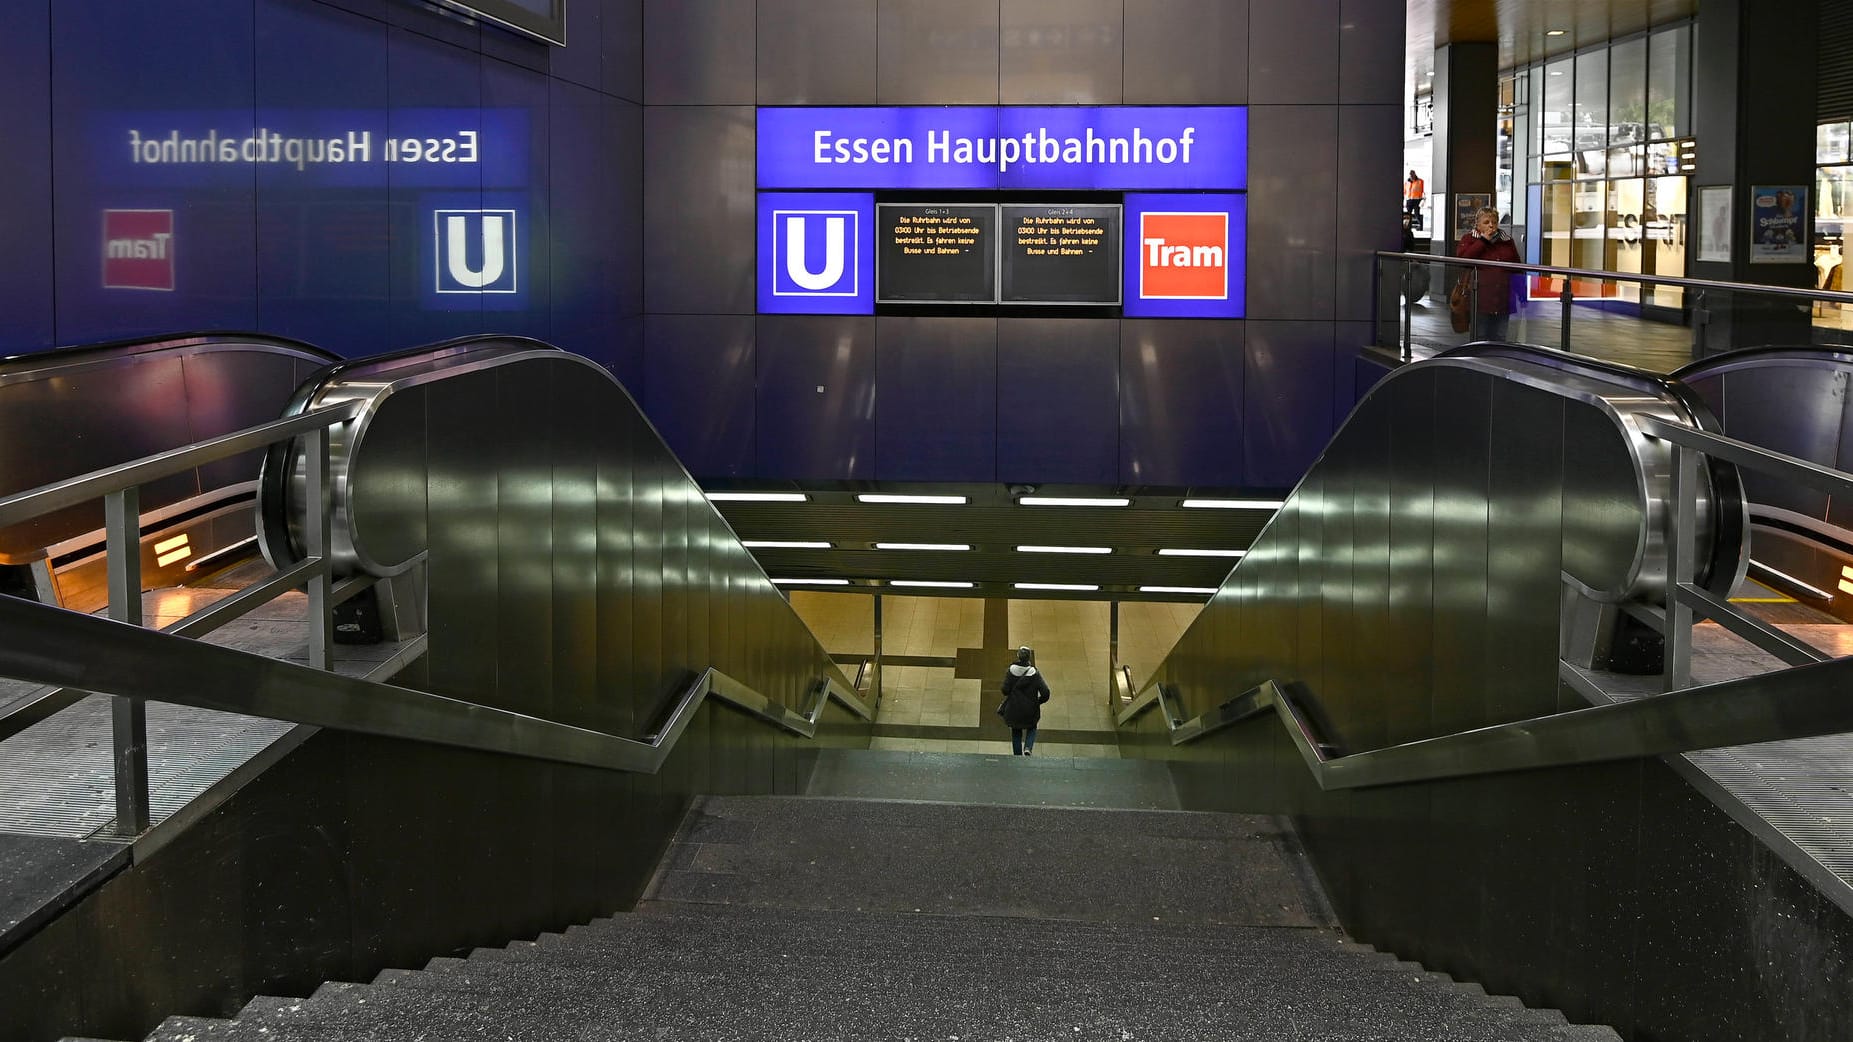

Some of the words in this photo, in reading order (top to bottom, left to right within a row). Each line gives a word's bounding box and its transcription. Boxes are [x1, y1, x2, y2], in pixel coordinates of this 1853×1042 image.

[813, 129, 913, 165] Essen
[927, 127, 1195, 173] Hauptbahnhof
[900, 216, 911, 224] Die
[912, 216, 941, 224] Ruhrbahn
[942, 216, 958, 224] wird
[913, 226, 925, 234] Uhr
[926, 226, 937, 234] bis
[938, 226, 980, 234] Betriebsende
[1037, 227, 1049, 235] Uhr
[1050, 227, 1060, 235] bis
[1061, 227, 1104, 235] Betriebsende
[926, 236, 934, 244] Es
[935, 237, 956, 245] fahren
[1050, 237, 1057, 245] Es
[1059, 237, 1080, 246] fahren
[786, 216, 845, 291] U
[1144, 237, 1223, 268] Tram
